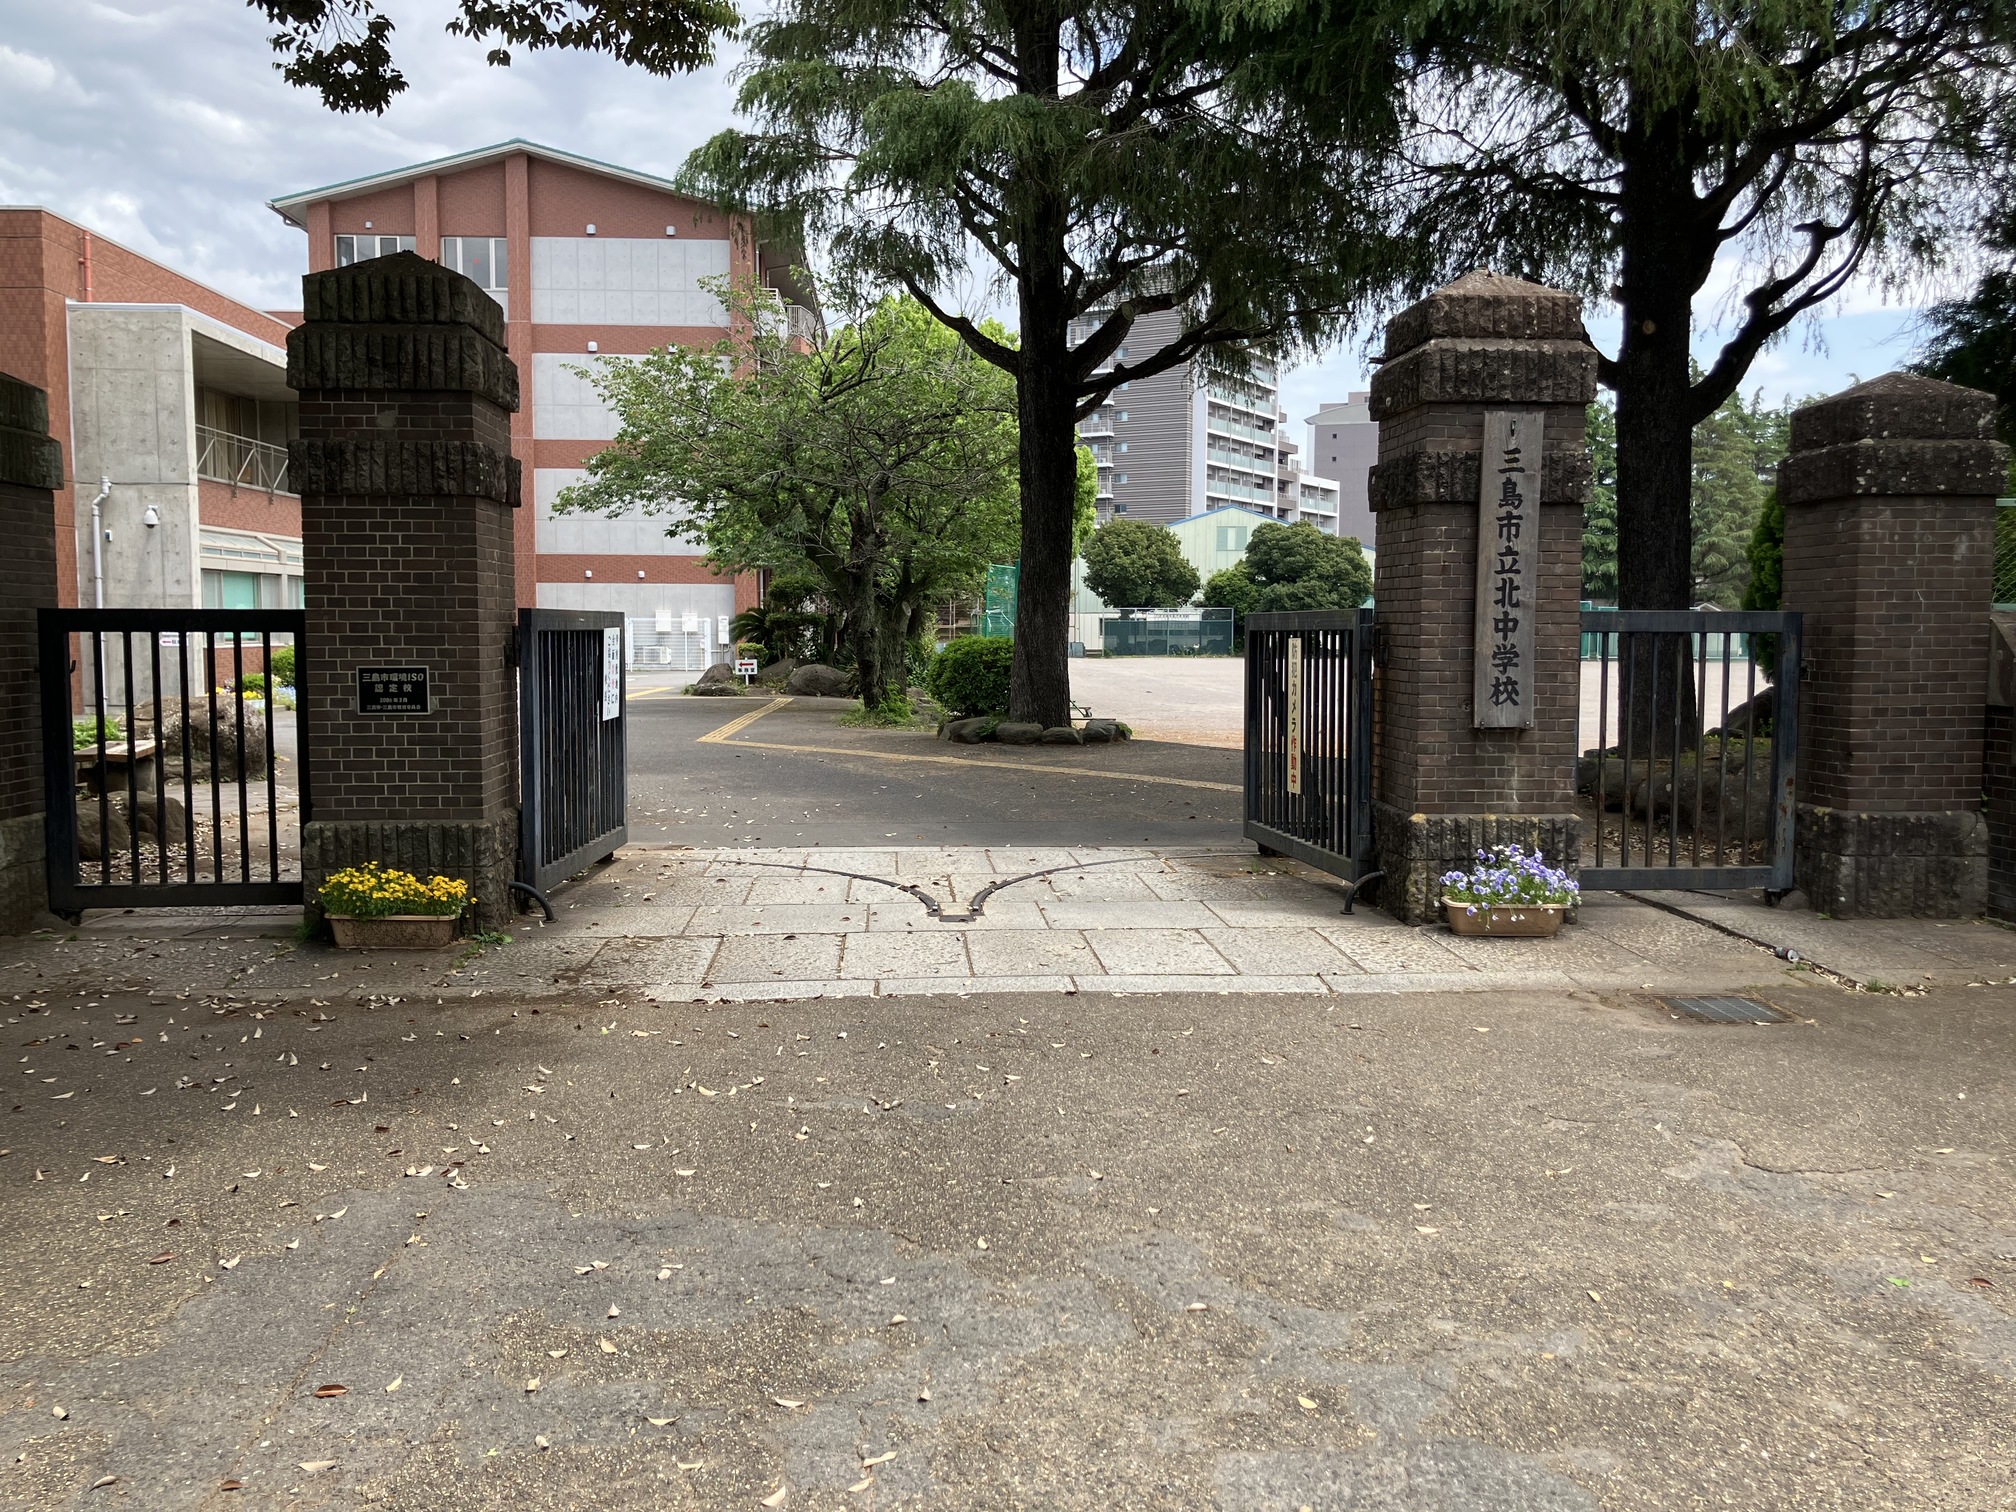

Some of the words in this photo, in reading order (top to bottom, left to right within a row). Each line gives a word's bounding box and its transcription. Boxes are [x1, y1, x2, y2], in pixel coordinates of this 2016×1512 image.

[1488, 447, 1526, 707] 三島市立北中学校
[362, 672, 425, 682] 三島市環境ISO
